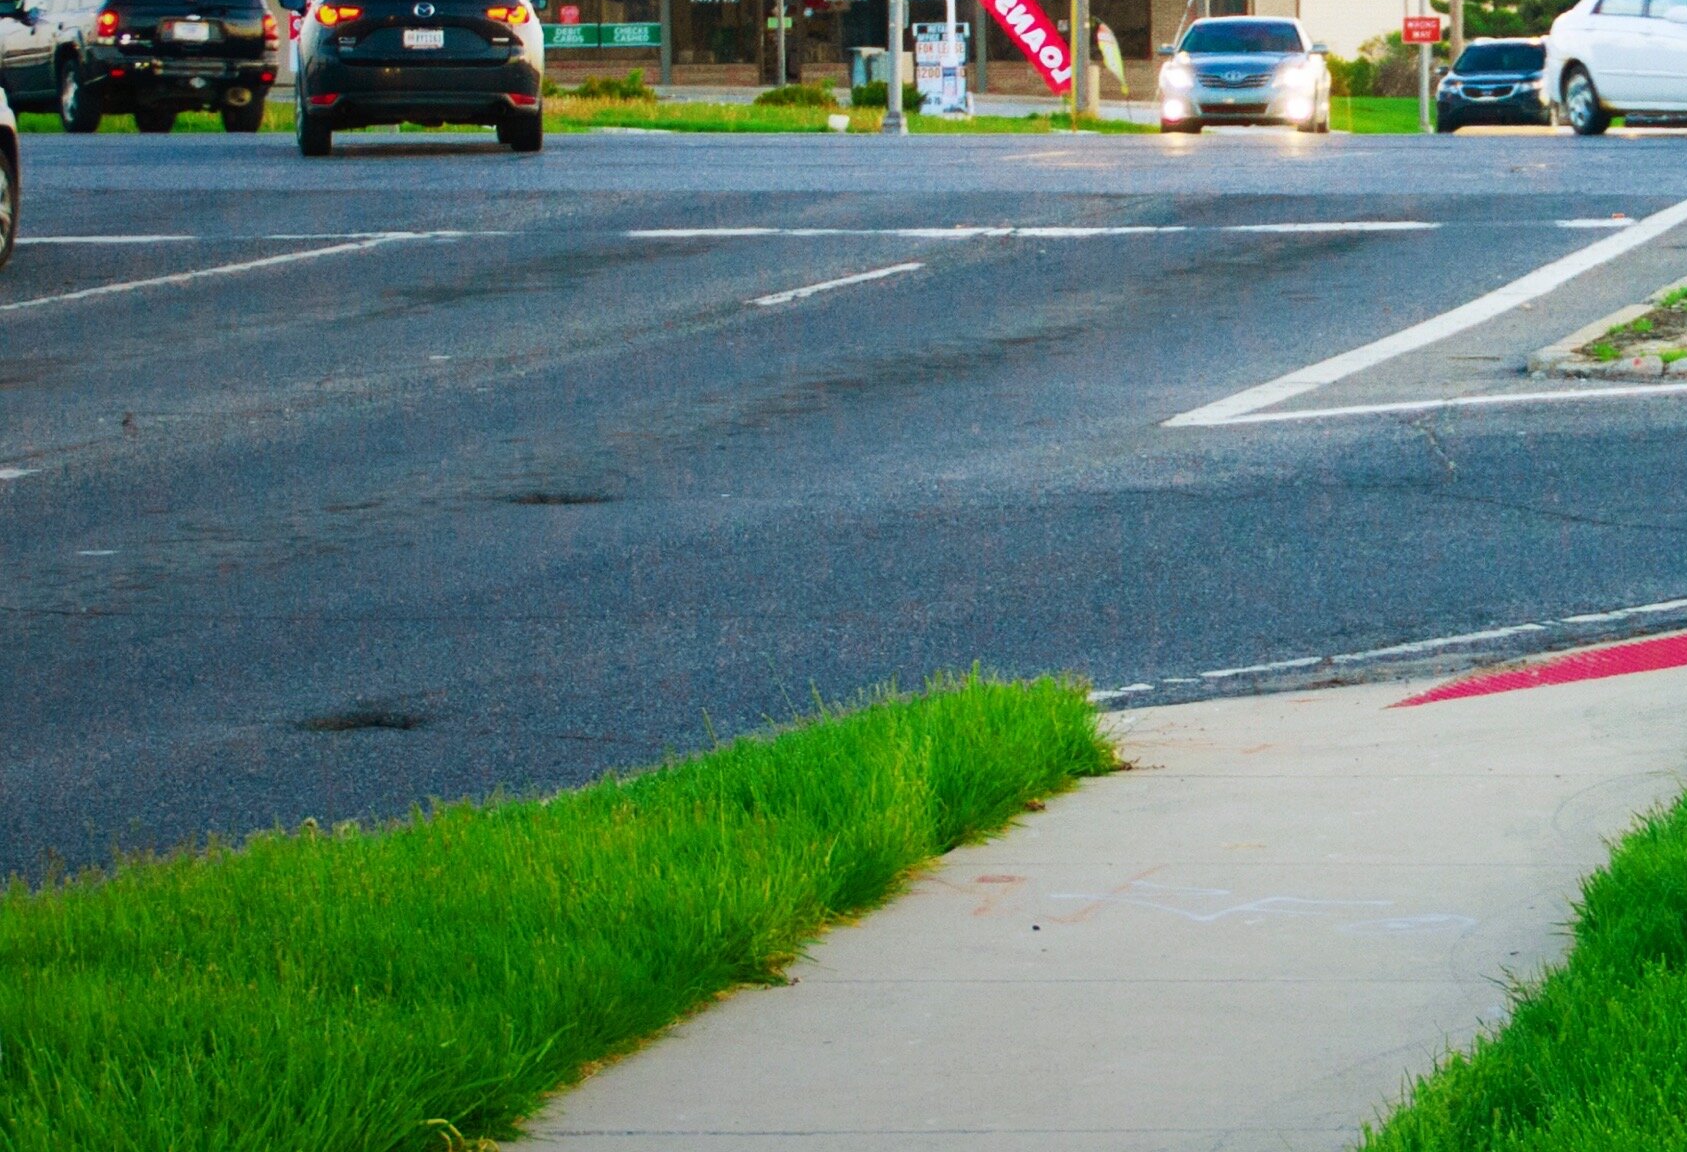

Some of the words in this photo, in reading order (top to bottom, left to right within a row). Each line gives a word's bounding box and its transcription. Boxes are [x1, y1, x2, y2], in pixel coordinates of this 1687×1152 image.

[555, 27, 582, 35] DEBIT
[613, 26, 649, 35] CHECKS
[553, 35, 584, 43] CARDS
[613, 34, 650, 42] CASHED
[938, 43, 965, 54] LESE
